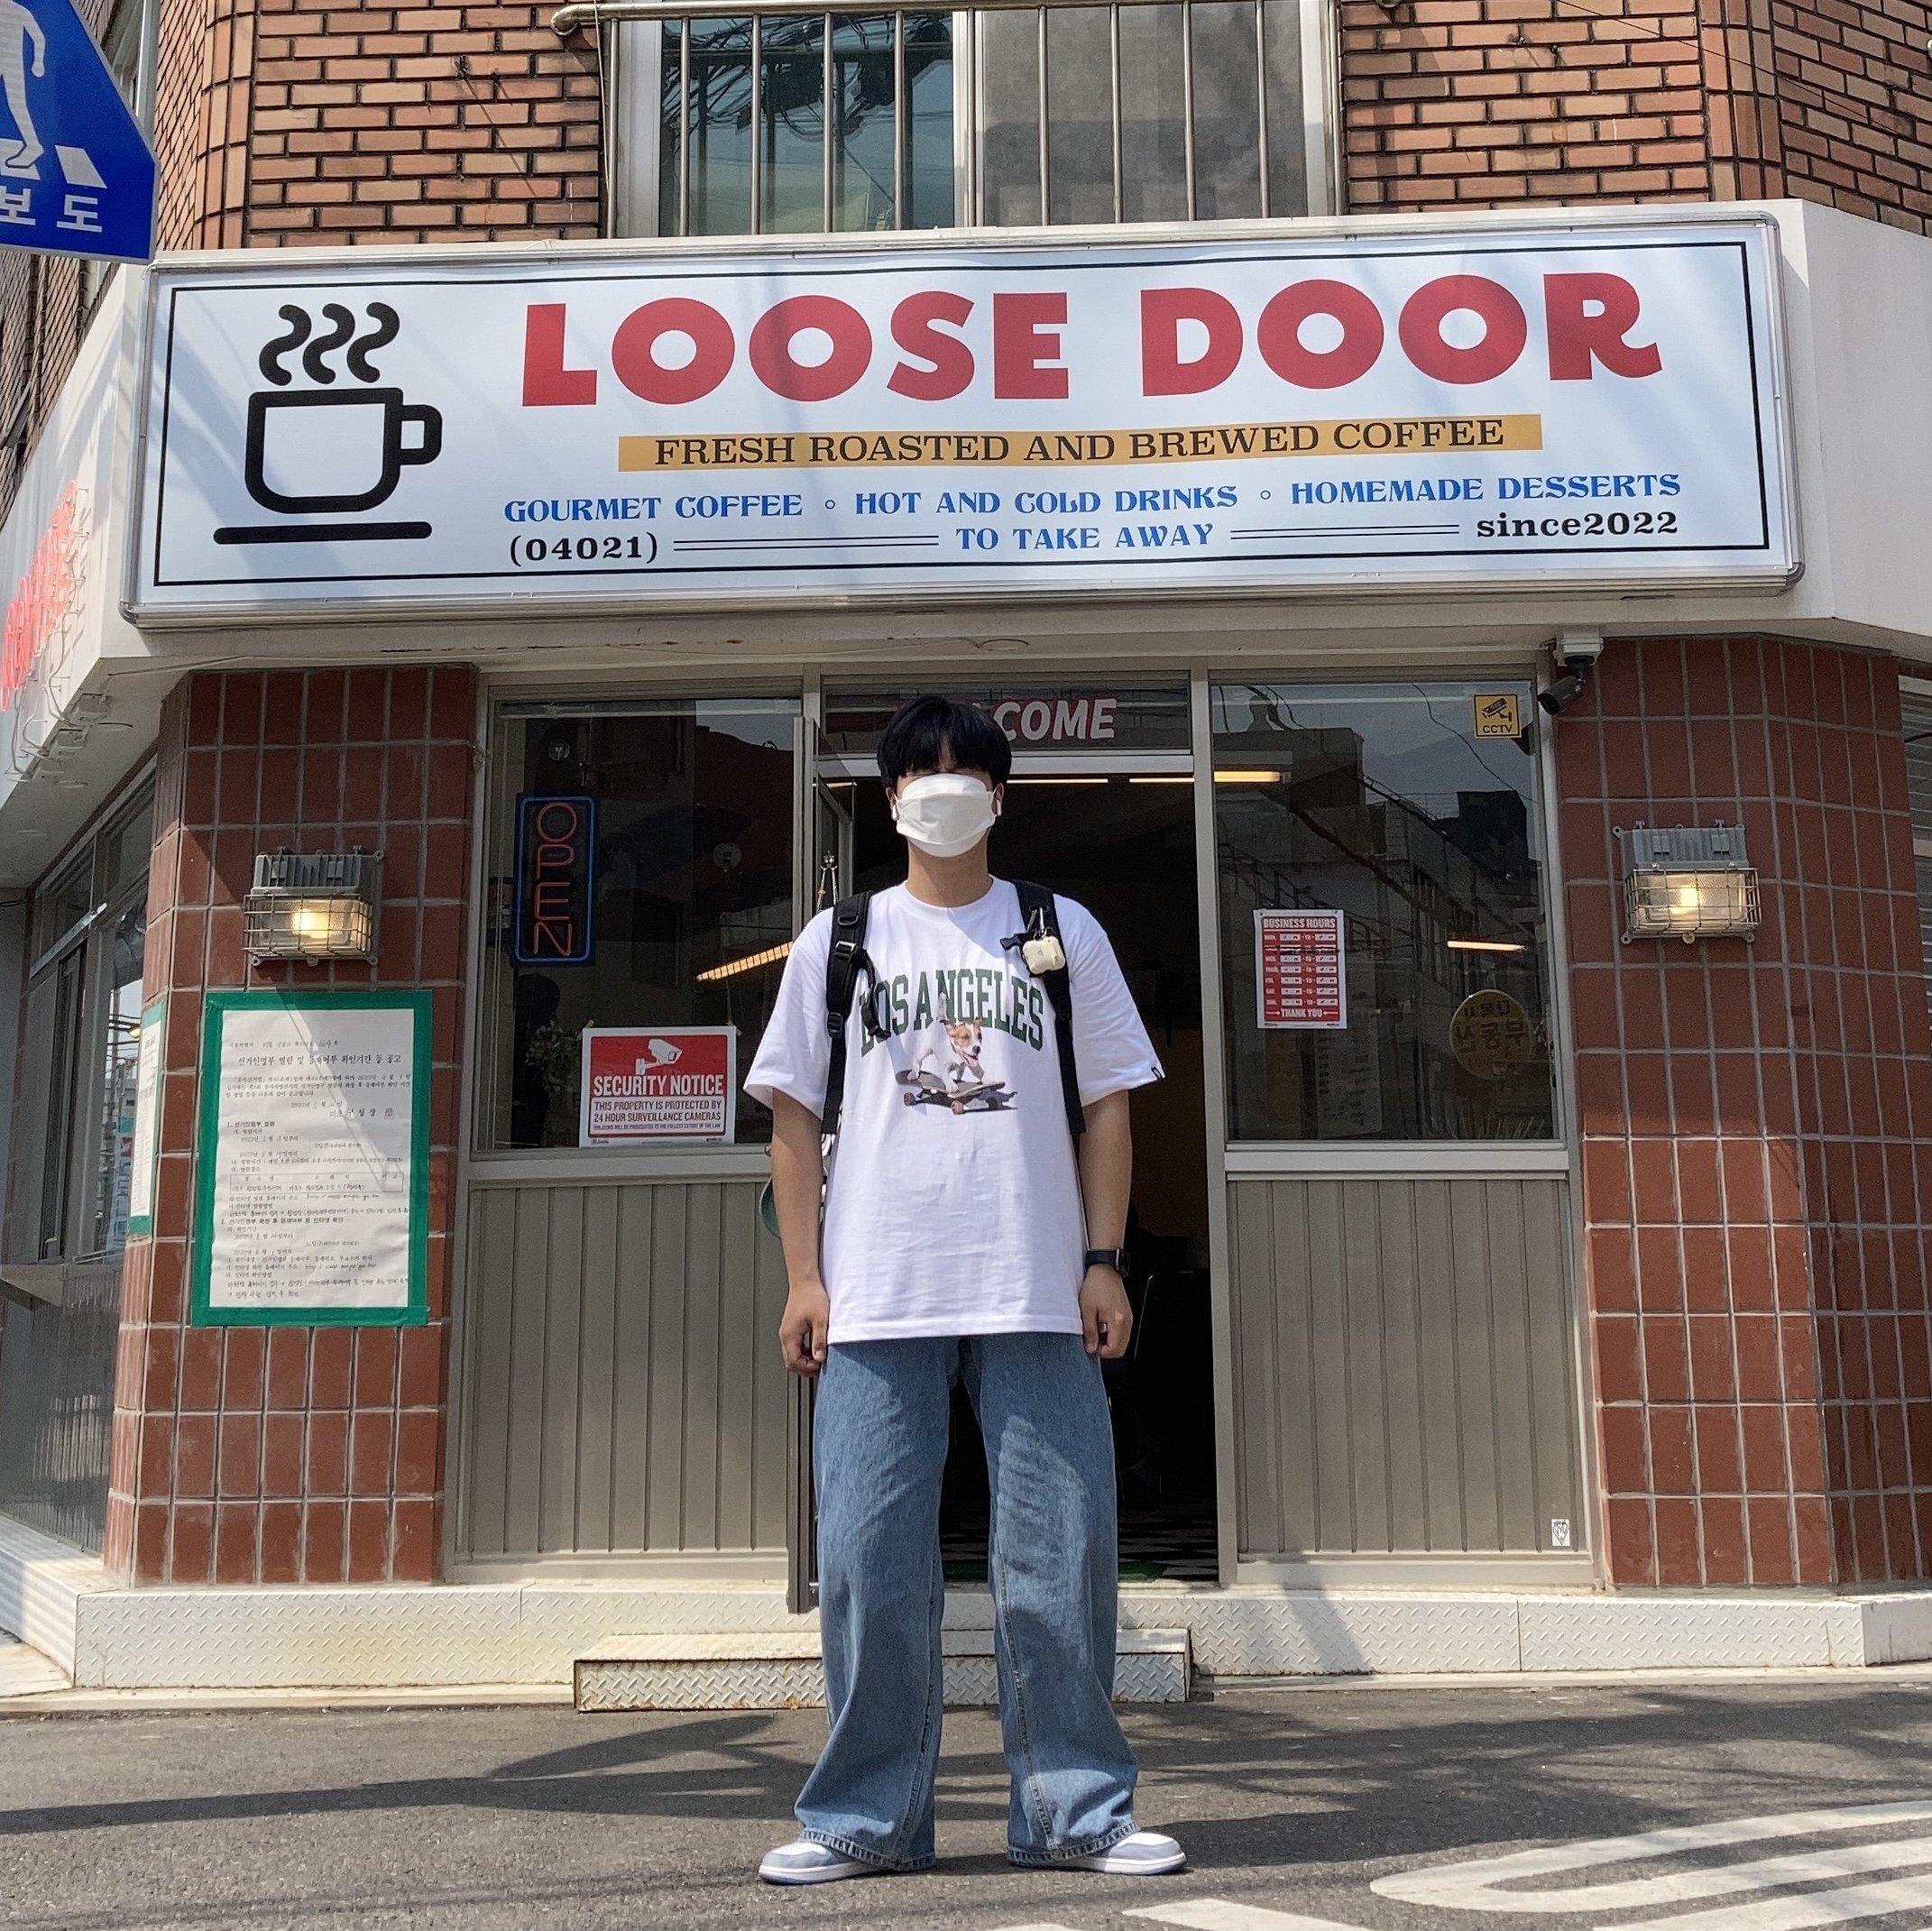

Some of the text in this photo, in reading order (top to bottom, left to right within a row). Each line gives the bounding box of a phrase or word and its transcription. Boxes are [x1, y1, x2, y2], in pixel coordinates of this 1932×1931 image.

[522, 271, 1662, 407] LOOSE DOOR
[655, 418, 1504, 466] FRESH ROASTED AND BREWED COFFEE
[504, 473, 1681, 522] GOURMET COFFEE HOT AND COLD DRINKS HOMEMADE DESSERTS
[955, 522, 1214, 550] TO TAKE AWAY
[1476, 510, 1679, 539] since2022
[510, 531, 659, 566] (04021)
[972, 698, 1118, 741] COME
[1482, 724, 1513, 734] CCTV
[534, 801, 578, 957] OPEN
[1263, 918, 1336, 929] BUSINESS HOURS
[913, 968, 1044, 1052] ANGELES
[1281, 1008, 1322, 1017] THANK YOU
[593, 1074, 724, 1097] SECURITY NOTICE
[593, 1111, 722, 1123] 24 HOUR SURVEILLANCE CAMERAS
[594, 1099, 722, 1111] THIS PROPERTY IS PROTECTED BY
